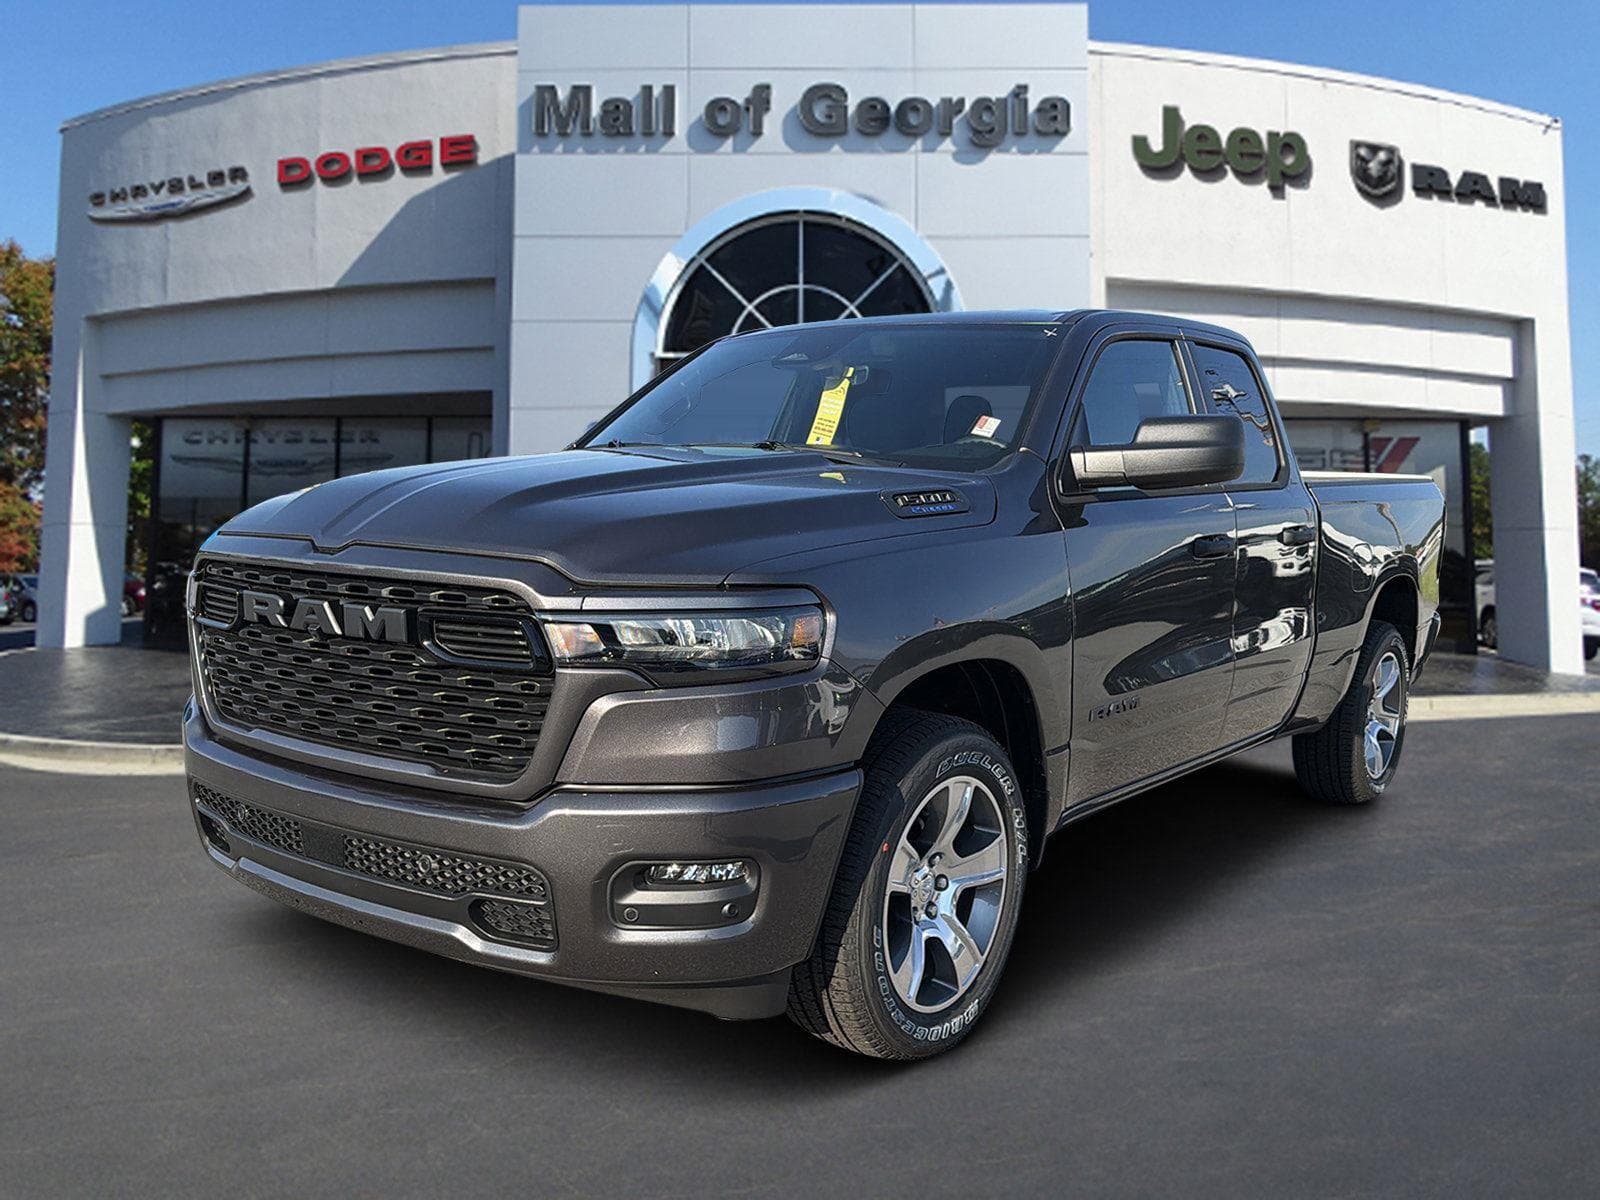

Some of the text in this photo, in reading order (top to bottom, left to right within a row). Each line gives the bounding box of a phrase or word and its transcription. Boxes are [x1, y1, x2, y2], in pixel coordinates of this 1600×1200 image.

[532, 82, 1074, 149] Mall of Georgia
[277, 134, 479, 187] DODGE
[1131, 105, 1310, 197] Jeep
[88, 165, 250, 208] CHRYSLER
[1410, 162, 1548, 215] RAM
[242, 588, 410, 644] RAM
[936, 752, 1015, 796] DUELER
[873, 925, 982, 1042] BRIDGESTONE
